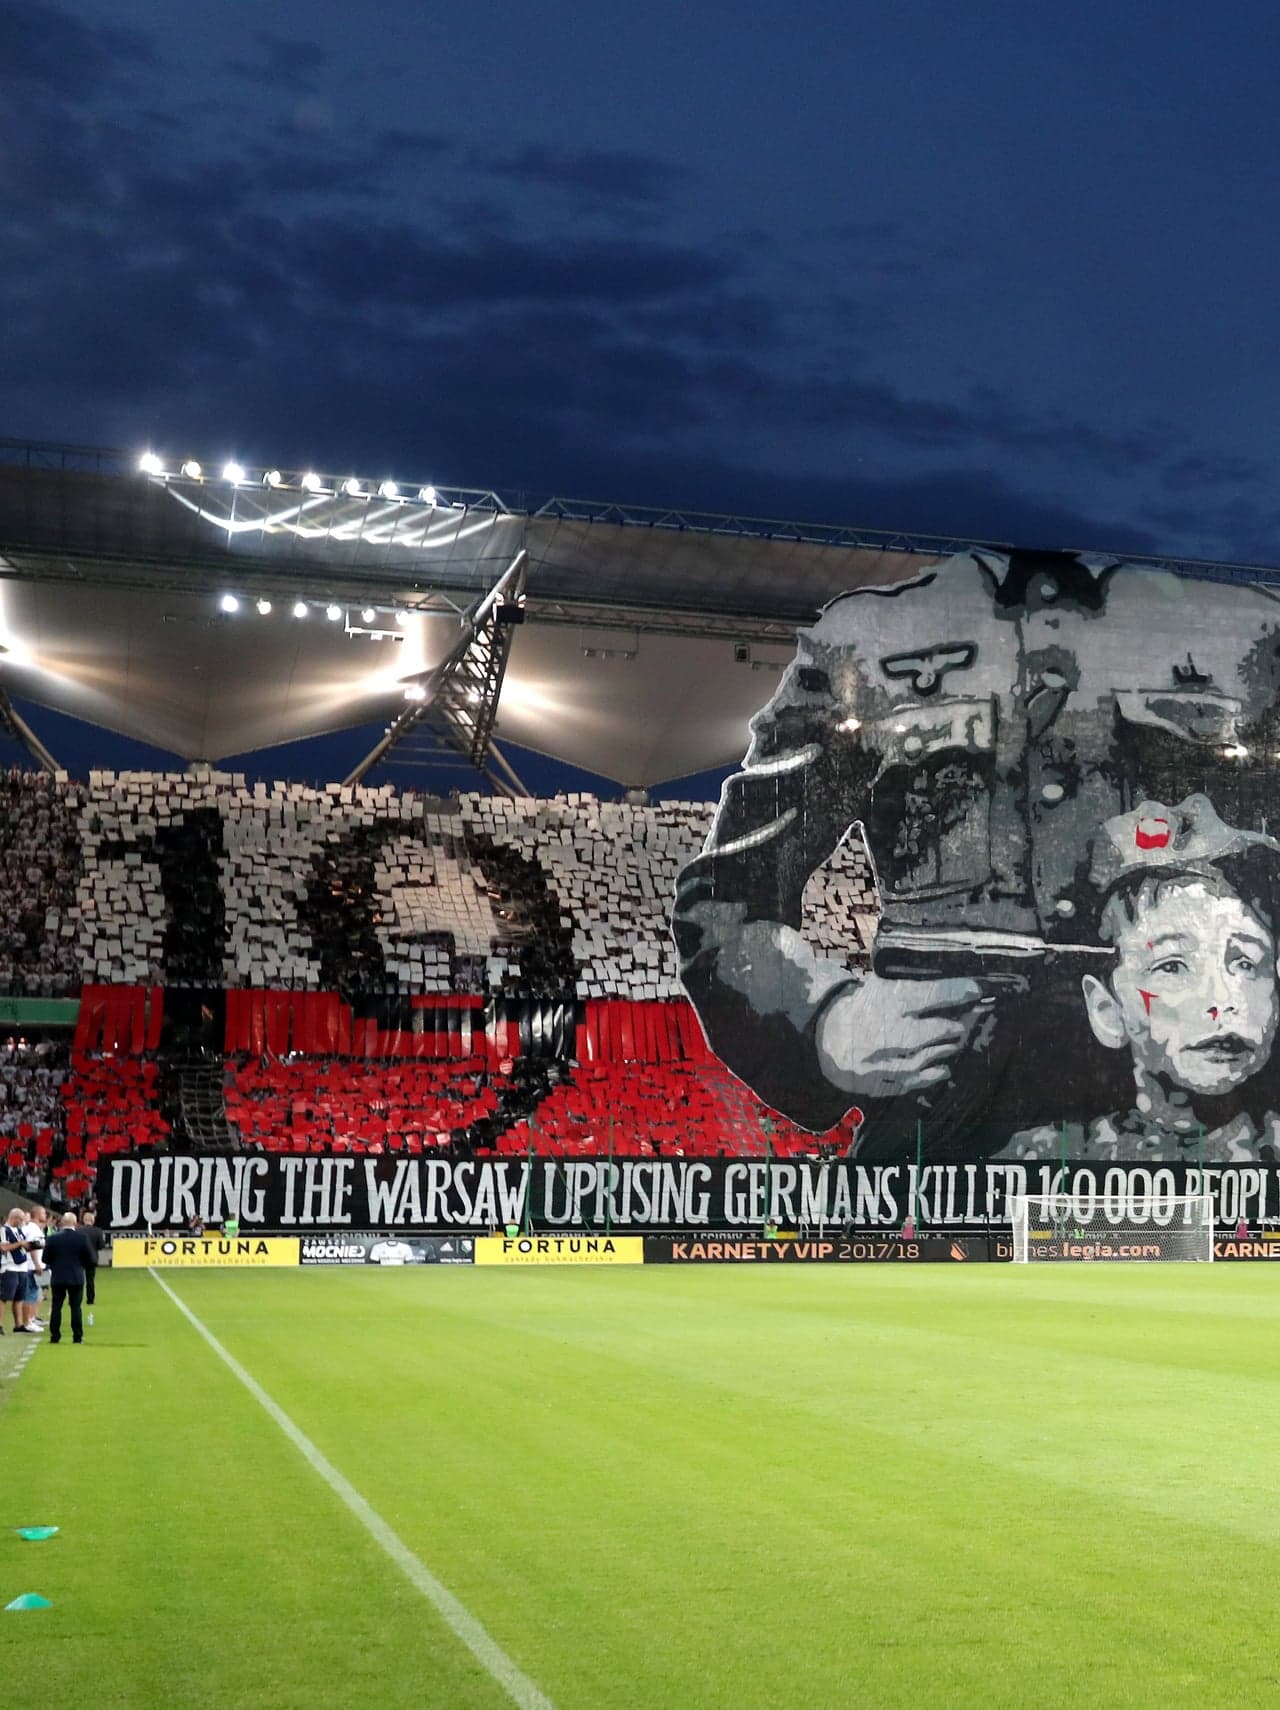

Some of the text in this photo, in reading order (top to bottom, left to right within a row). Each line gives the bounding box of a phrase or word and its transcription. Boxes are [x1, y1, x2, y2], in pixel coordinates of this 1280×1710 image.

[110, 1156, 269, 1227] DURING
[280, 1157, 354, 1224] THE
[364, 1159, 532, 1225] WARSAW
[544, 1162, 712, 1224] UPRISING
[724, 1163, 900, 1224] GERMANS
[906, 1164, 1027, 1224] KILLED
[1039, 1165, 1097, 1224] 160
[1104, 1167, 1176, 1226] 000
[144, 1241, 269, 1255] FORTUNA
[503, 1240, 616, 1253] FORTUNA
[672, 1242, 919, 1259] KARNETY VIP 2017/18
